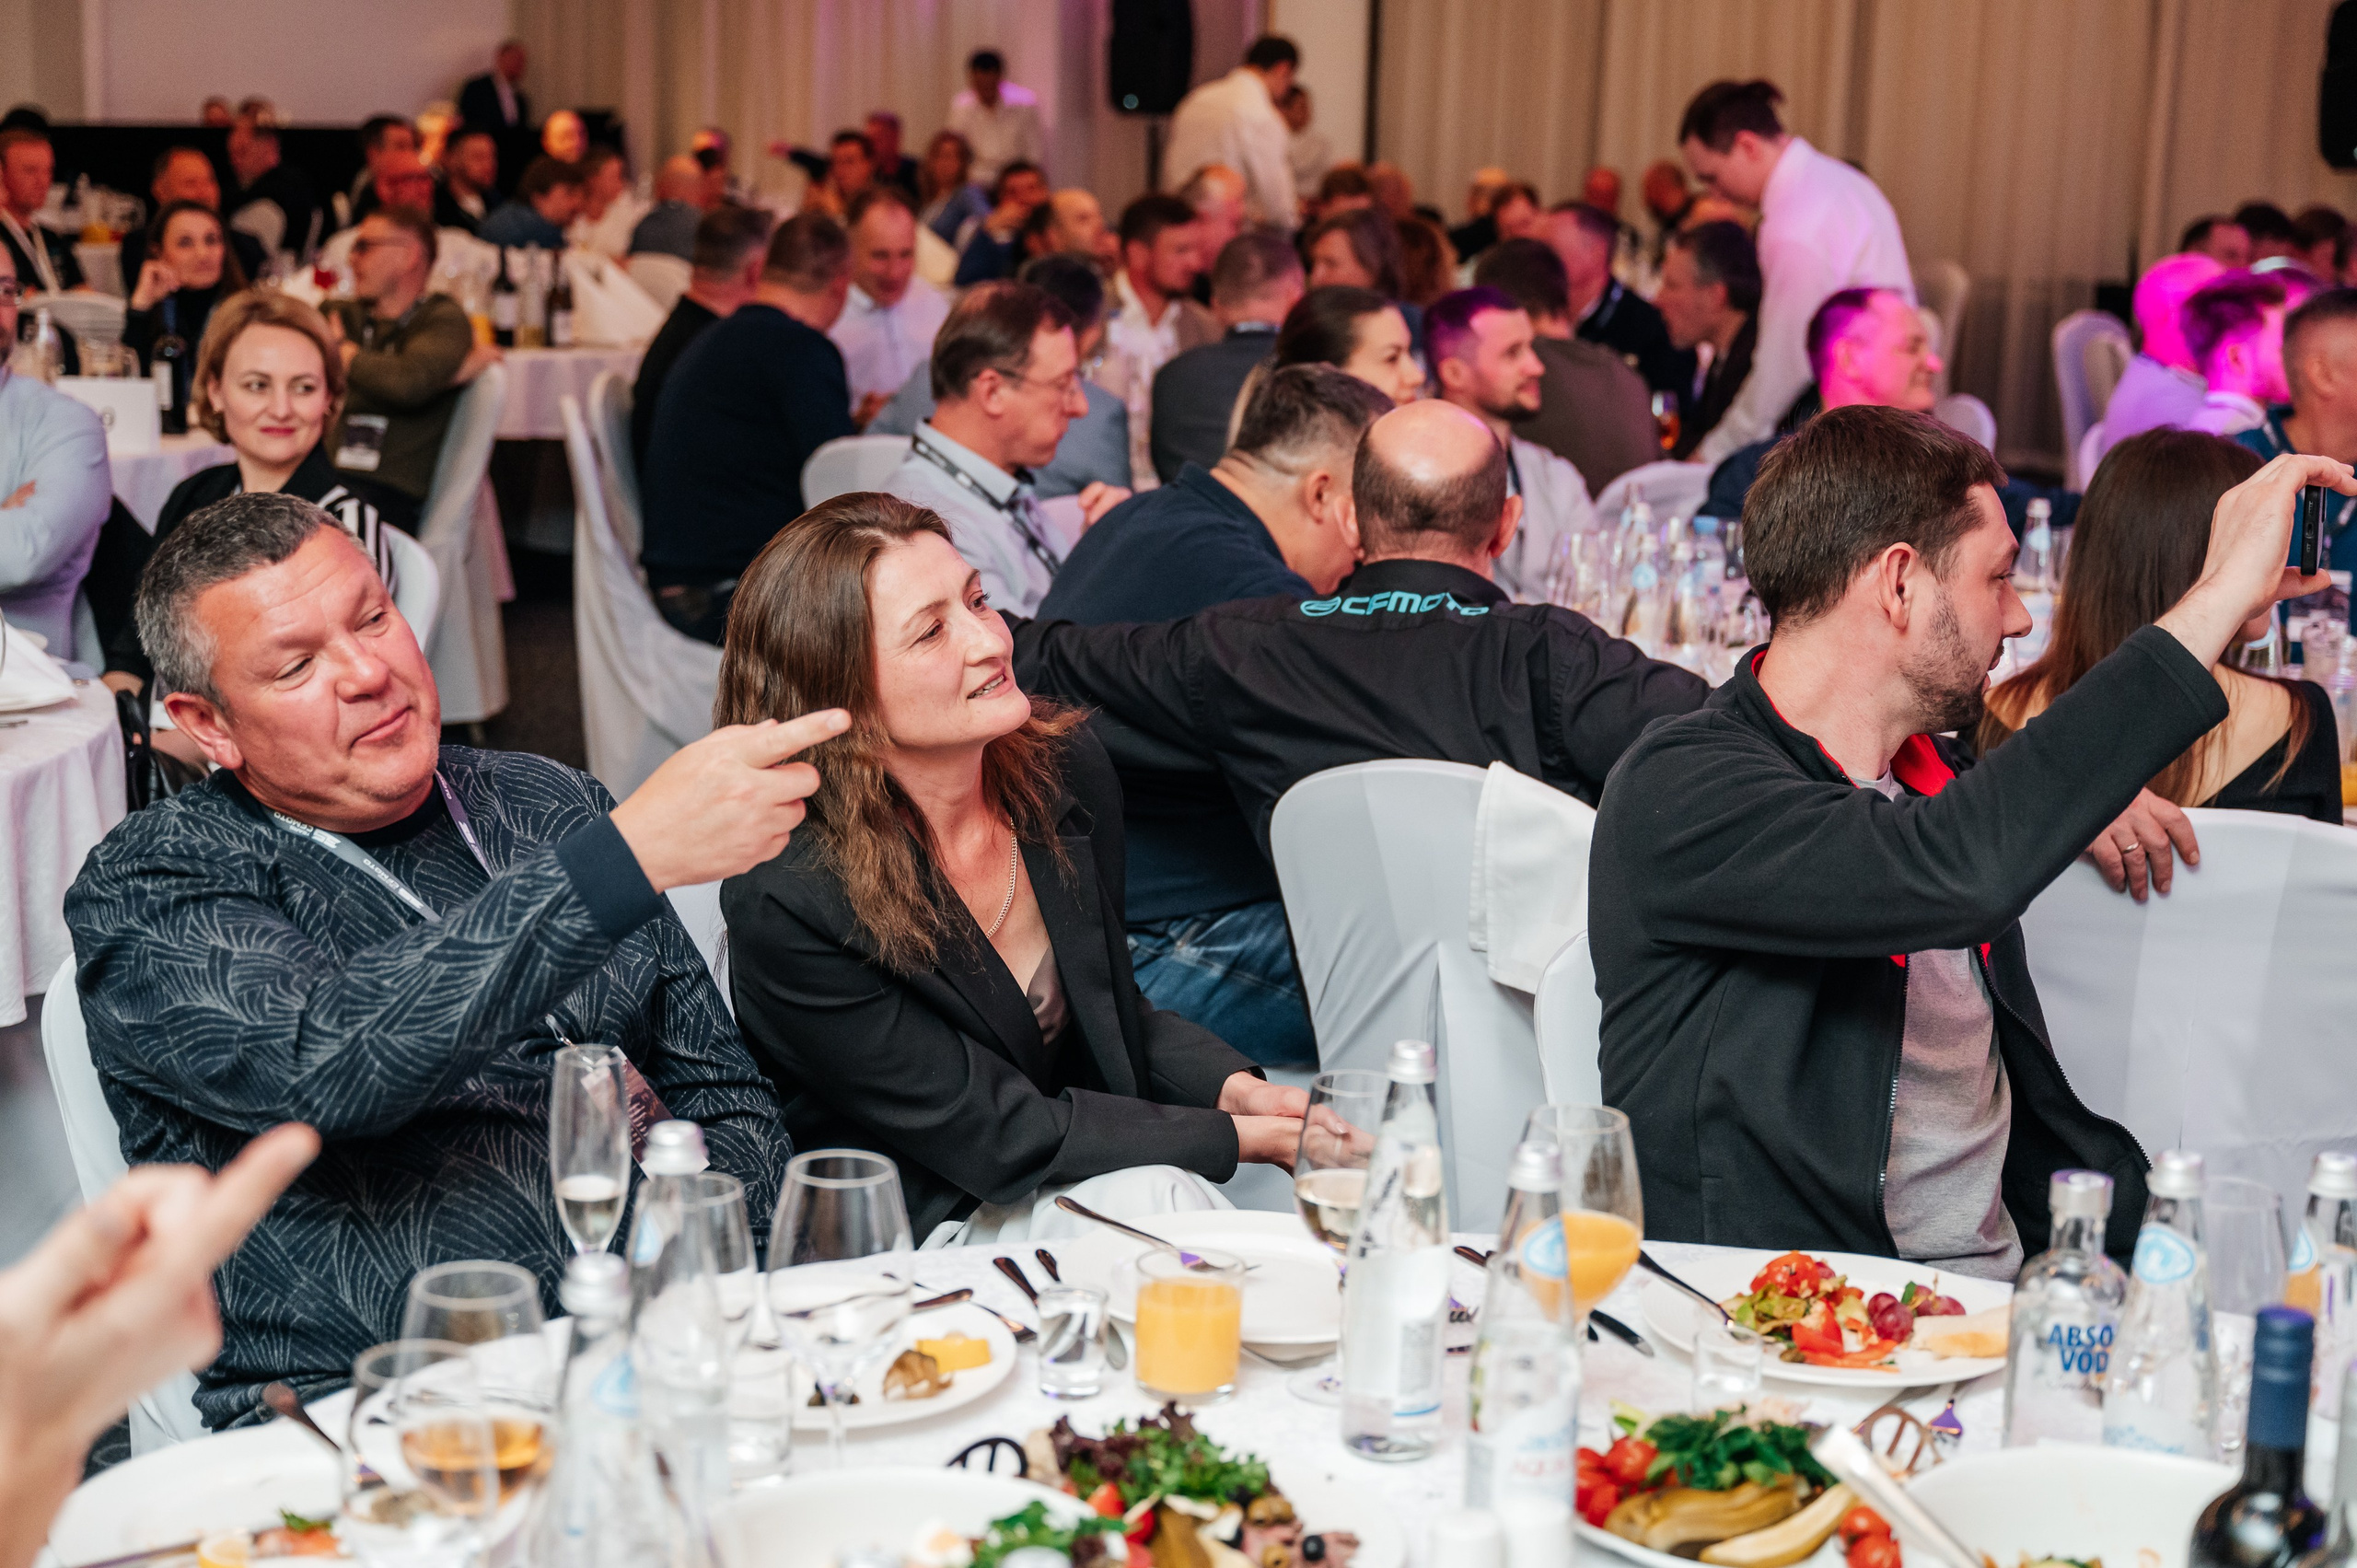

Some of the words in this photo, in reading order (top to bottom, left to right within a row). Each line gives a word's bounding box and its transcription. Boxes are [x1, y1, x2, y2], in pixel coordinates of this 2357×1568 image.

[1341, 591, 1490, 616] CFMOTO
[273, 811, 314, 832] CFMOTO
[2048, 1324, 2113, 1349] ABSO
[2059, 1350, 2109, 1374] VOD
